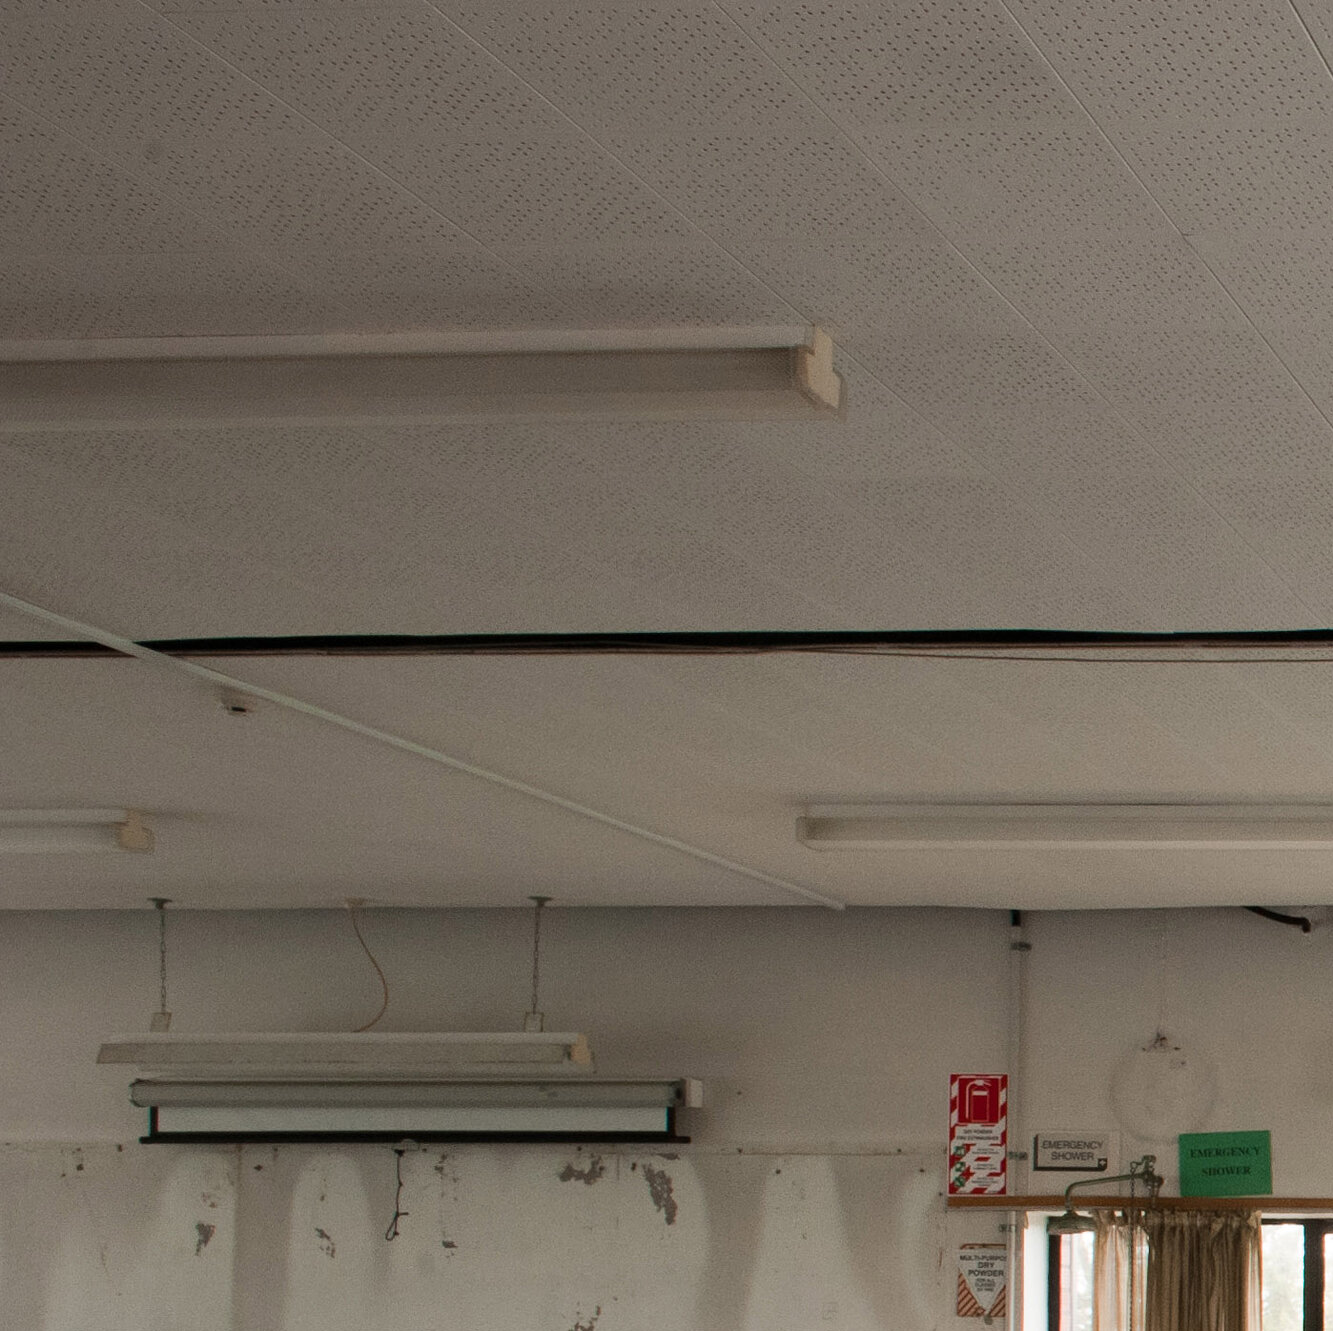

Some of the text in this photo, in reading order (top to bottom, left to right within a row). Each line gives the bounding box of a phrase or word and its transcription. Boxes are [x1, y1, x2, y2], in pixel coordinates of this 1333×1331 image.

[1042, 1140, 1103, 1150] EMERGENCY
[1051, 1152, 1094, 1161] SHOWER
[1190, 1146, 1261, 1158] EMERGENCY
[1201, 1166, 1251, 1176] SHOWER
